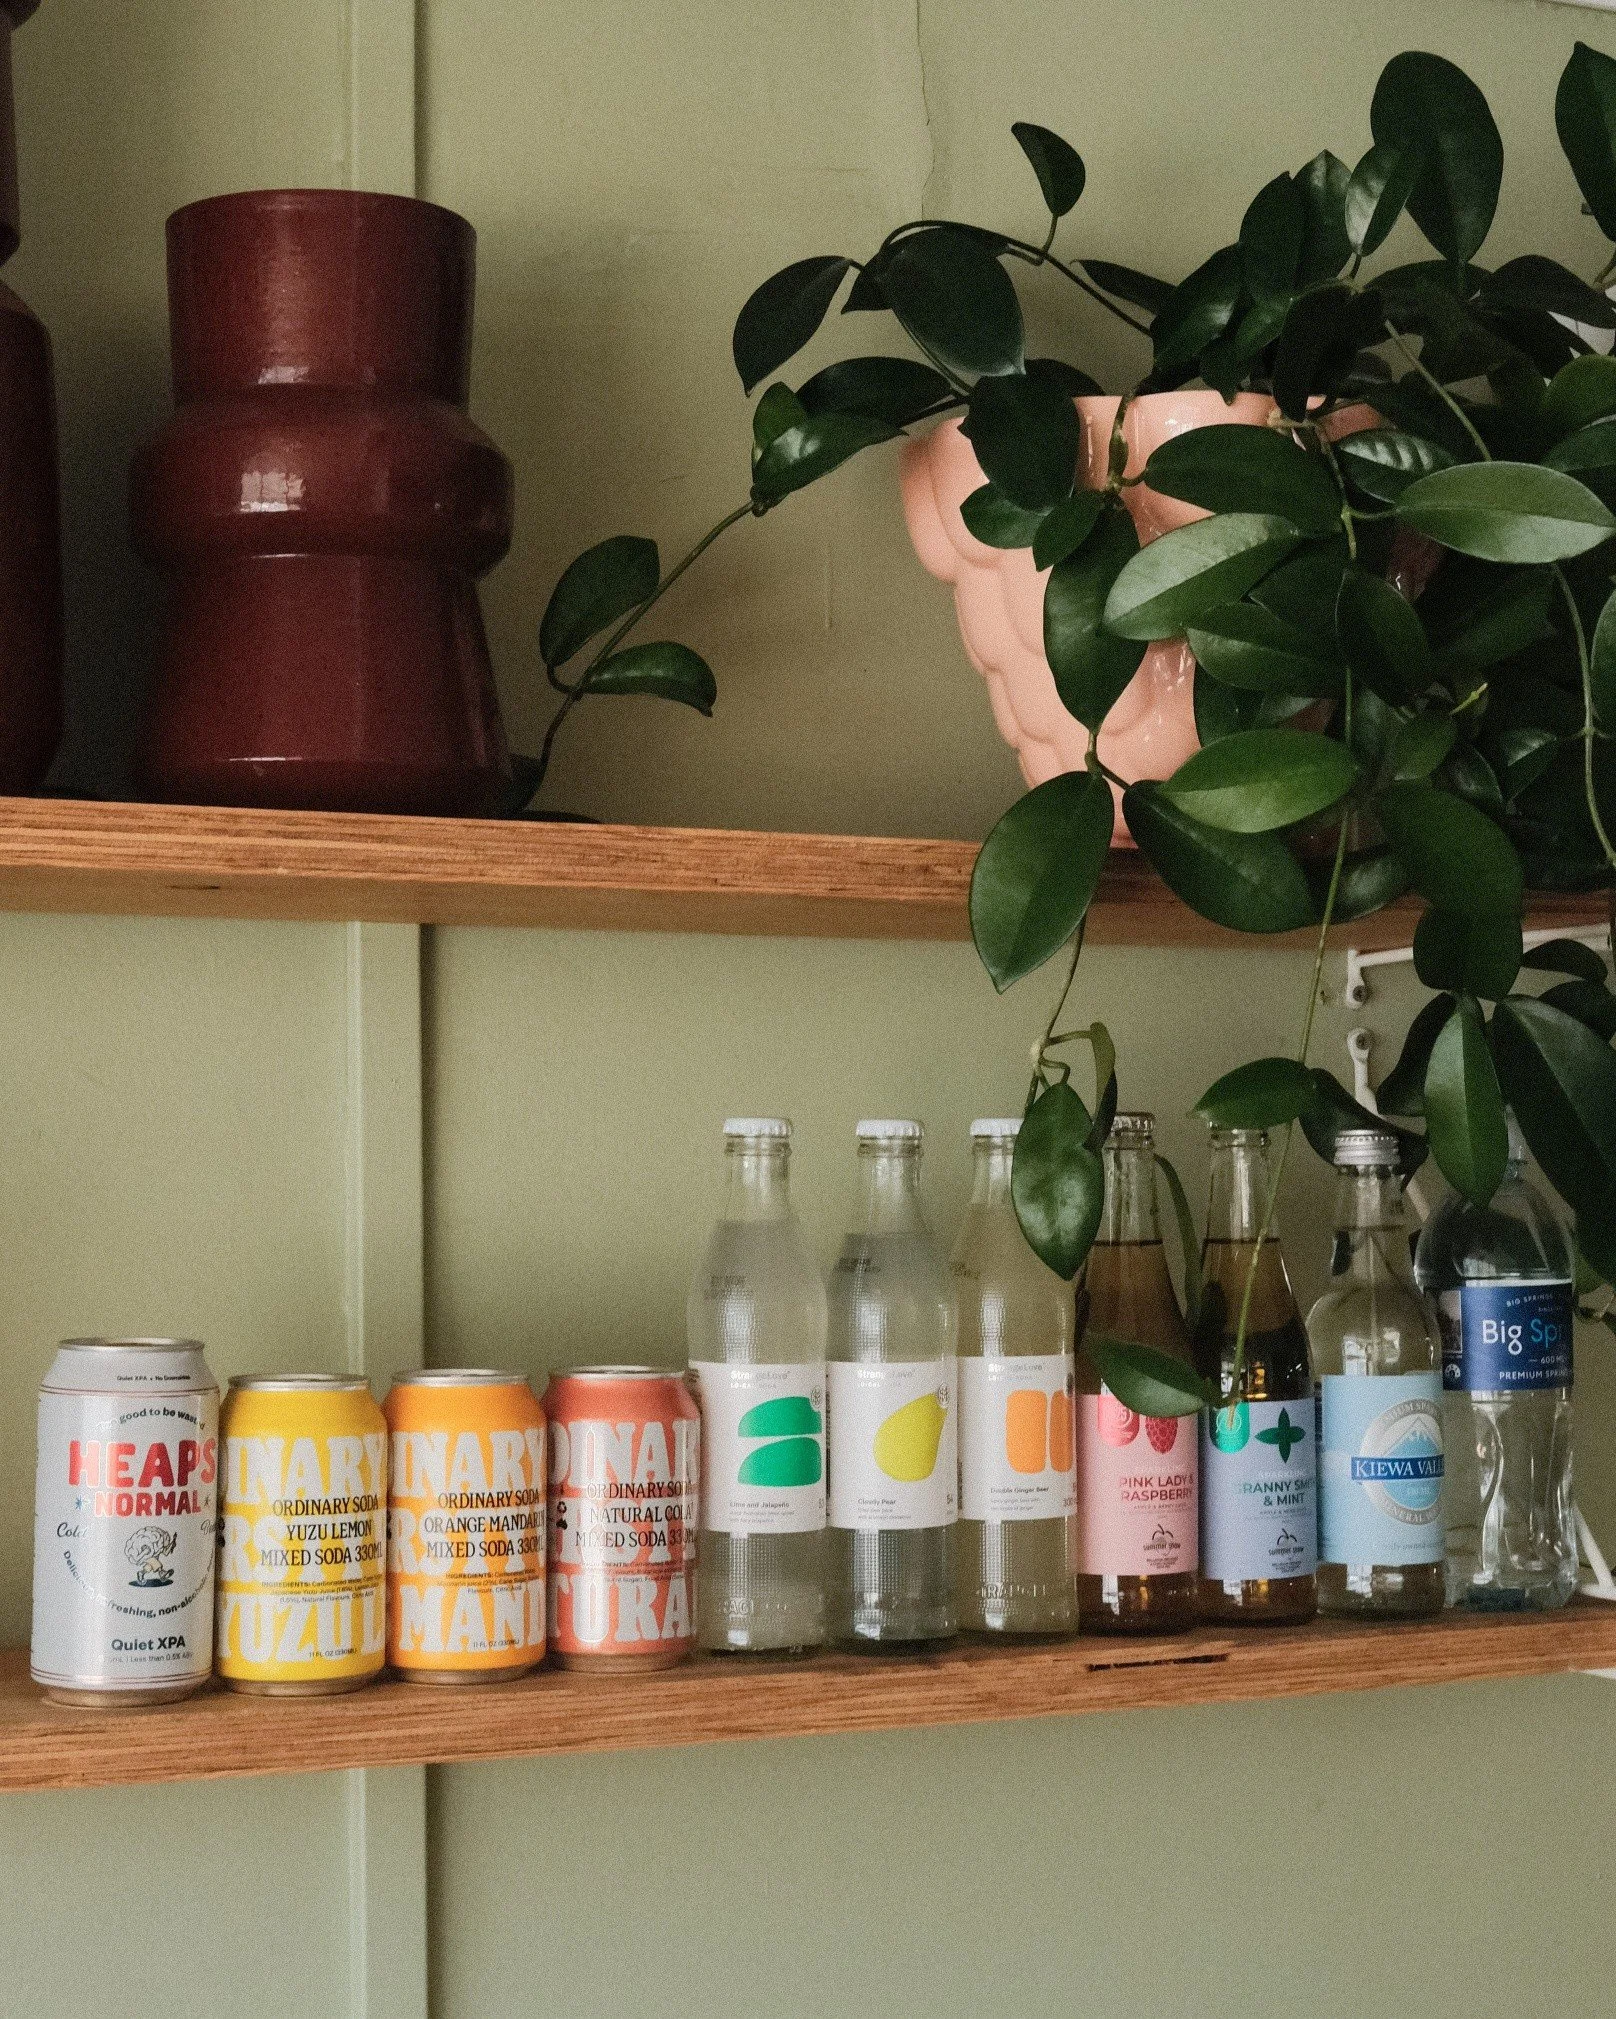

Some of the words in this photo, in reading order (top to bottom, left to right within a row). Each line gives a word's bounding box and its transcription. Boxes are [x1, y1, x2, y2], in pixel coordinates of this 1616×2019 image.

[1482, 1319, 1523, 1356] Big
[1499, 1370, 1543, 1380] PREMIUM
[119, 1408, 147, 1425] good
[149, 1407, 161, 1417] to
[162, 1406, 176, 1417] be
[177, 1410, 206, 1431] wastd
[68, 1437, 218, 1488] HEAPS
[1355, 1458, 1414, 1478] KIEWA
[587, 1481, 665, 1499] ORDINARY
[1119, 1474, 1153, 1488] PINK
[1158, 1473, 1186, 1487] LADY
[438, 1490, 514, 1509] ORDINARY
[515, 1487, 540, 1506] SODA
[1014, 1486, 1035, 1495] Ginger
[1121, 1487, 1193, 1502] RASPBERRY
[1263, 1496, 1273, 1507] &
[1276, 1492, 1305, 1506] MINT
[95, 1489, 202, 1518] NORMAL
[273, 1496, 351, 1517] ORDINARY
[352, 1494, 379, 1513] SODA
[857, 1498, 880, 1507] Cloudy
[590, 1505, 662, 1524] NATURAL
[286, 1523, 328, 1541] YUZU
[331, 1519, 372, 1540] LEMON
[424, 1515, 486, 1534] ORANGE
[576, 1531, 625, 1548] MIXED
[628, 1530, 667, 1548] SODA
[260, 1548, 312, 1567] MIXED
[314, 1546, 352, 1565] SODA
[426, 1541, 476, 1559] MIXED
[478, 1539, 516, 1557] SODA
[111, 1638, 154, 1652] Quiet
[157, 1635, 187, 1650] XPA
